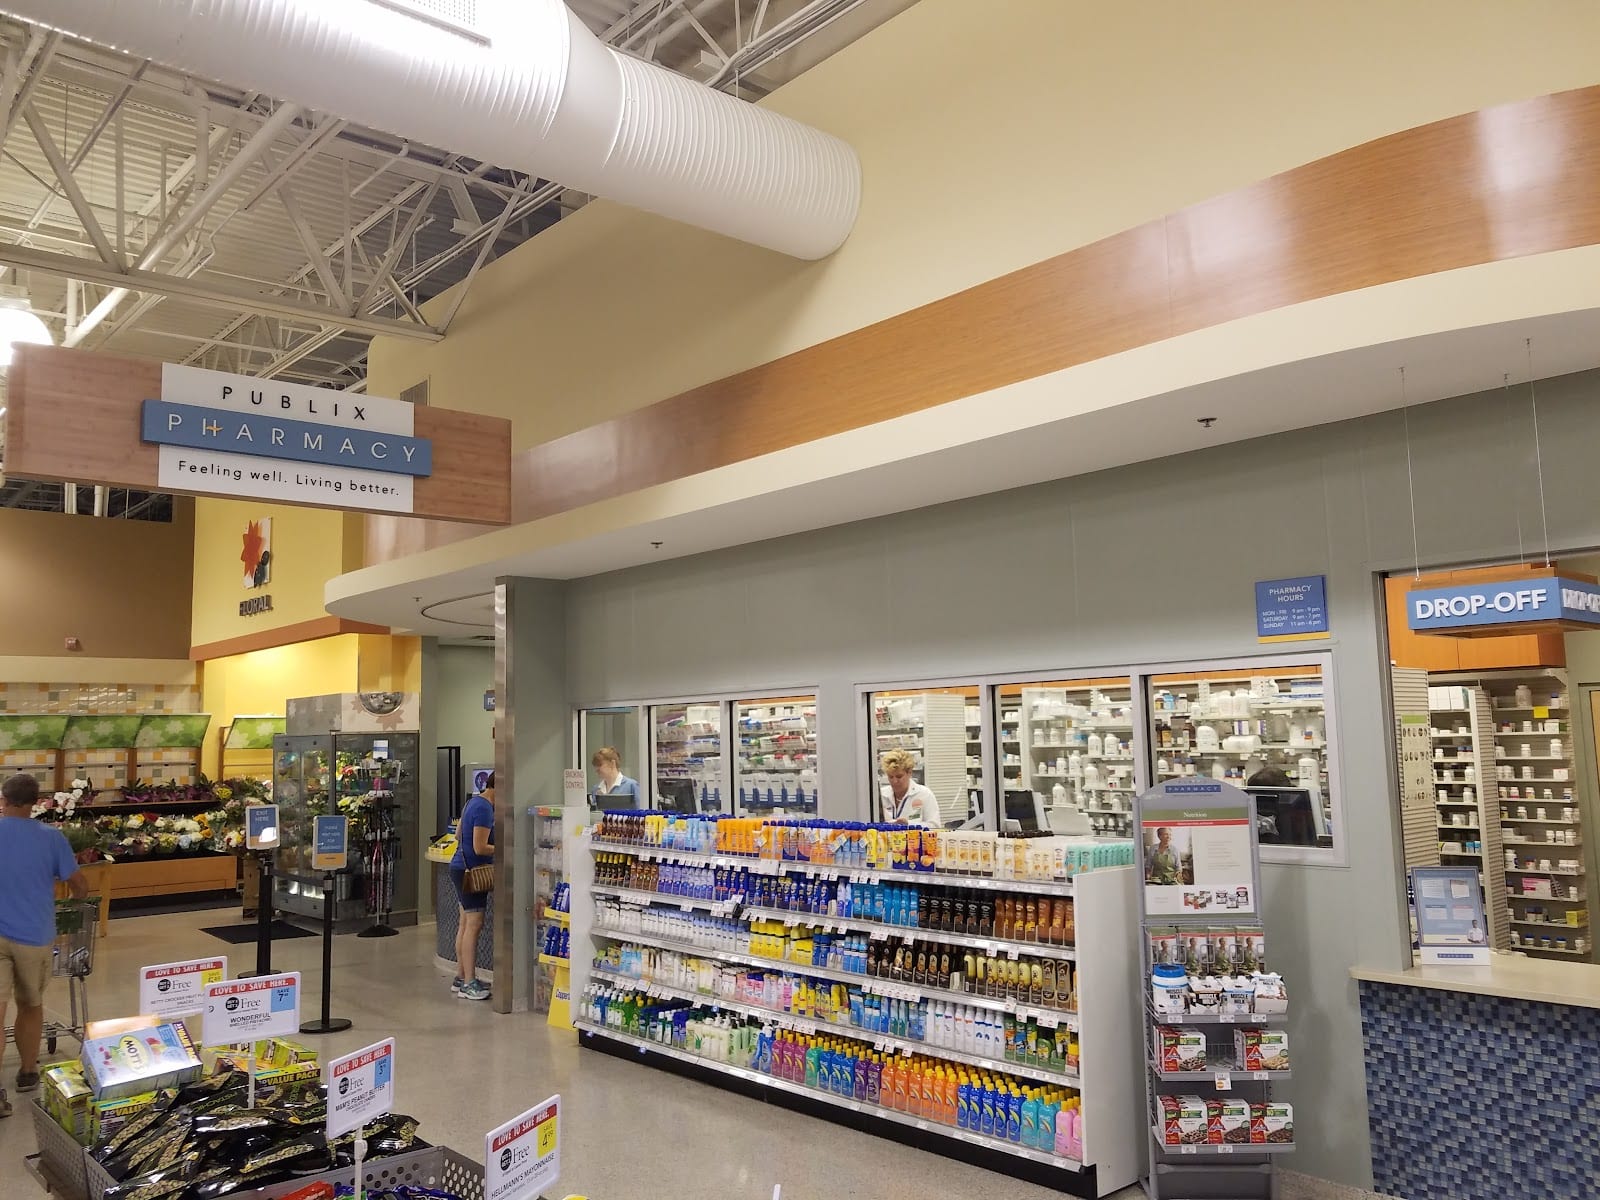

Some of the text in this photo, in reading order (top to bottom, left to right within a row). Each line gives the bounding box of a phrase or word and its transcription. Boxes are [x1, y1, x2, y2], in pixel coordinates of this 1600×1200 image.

[222, 386, 366, 421] PUBLIX
[168, 413, 416, 463] PHARMACY
[178, 460, 400, 496] Feeling well. Living better.
[1269, 585, 1312, 596] PHARMACY
[1278, 594, 1304, 602] HOURS
[1416, 589, 1547, 619] DROP-OFF
[240, 595, 271, 616] FLORAL
[155, 969, 170, 977] LOVE
[184, 964, 198, 972] SAVE
[172, 980, 192, 989] Free
[215, 987, 233, 995] LOVE
[249, 982, 266, 990] SAVE
[241, 998, 261, 1008] Free
[230, 1013, 270, 1022] WONDERFUL
[337, 1063, 350, 1074] LOVE
[352, 1058, 358, 1068] TO
[360, 1053, 372, 1064] SAVE
[267, 1074, 294, 1085] VALUE
[296, 1070, 318, 1080] PACK
[350, 1078, 364, 1090] Free
[351, 1091, 368, 1104] PEANUT
[116, 1104, 146, 1116] VALUE
[498, 1132, 512, 1145] LOVE
[514, 1127, 520, 1136] TO
[522, 1120, 535, 1131] SAVE
[513, 1146, 530, 1164] Free
[491, 1173, 523, 1199] HELLMANN'S
[524, 1153, 554, 1178] MAYONNAISE
